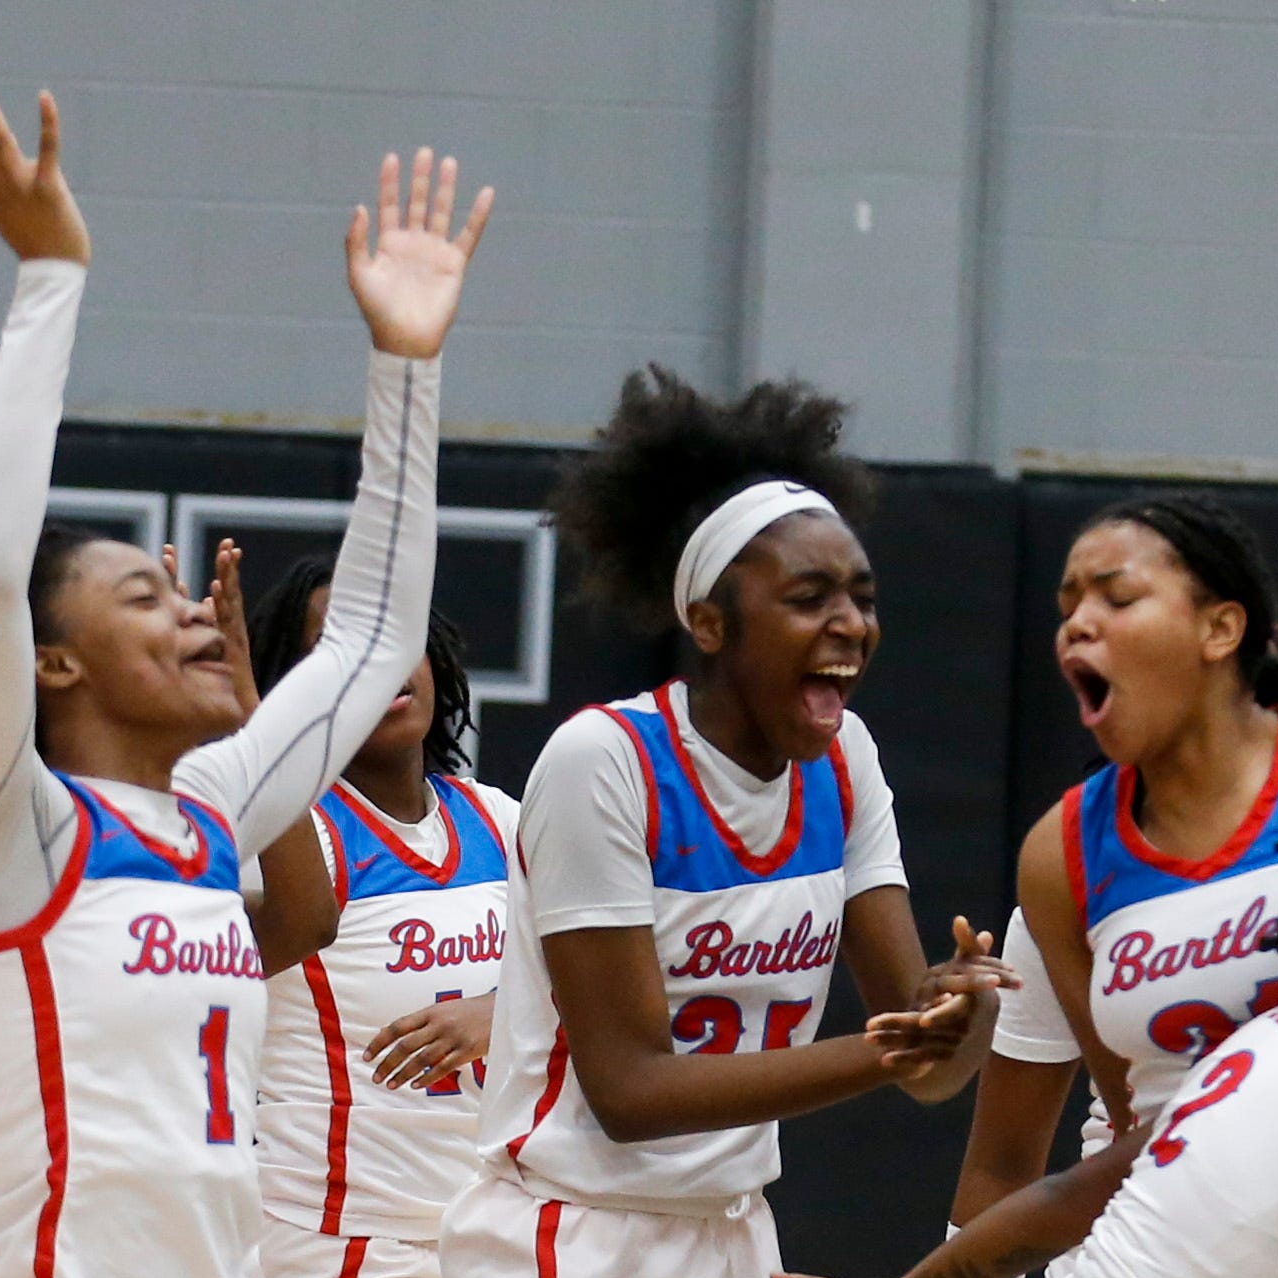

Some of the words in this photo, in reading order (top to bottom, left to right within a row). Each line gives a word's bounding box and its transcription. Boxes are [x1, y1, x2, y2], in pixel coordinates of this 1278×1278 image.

[123, 913, 266, 980] Bartle
[386, 908, 506, 973] Bartl
[668, 910, 839, 979] Bartlett
[199, 1004, 235, 1144] 1
[1149, 1049, 1255, 1168] 2
